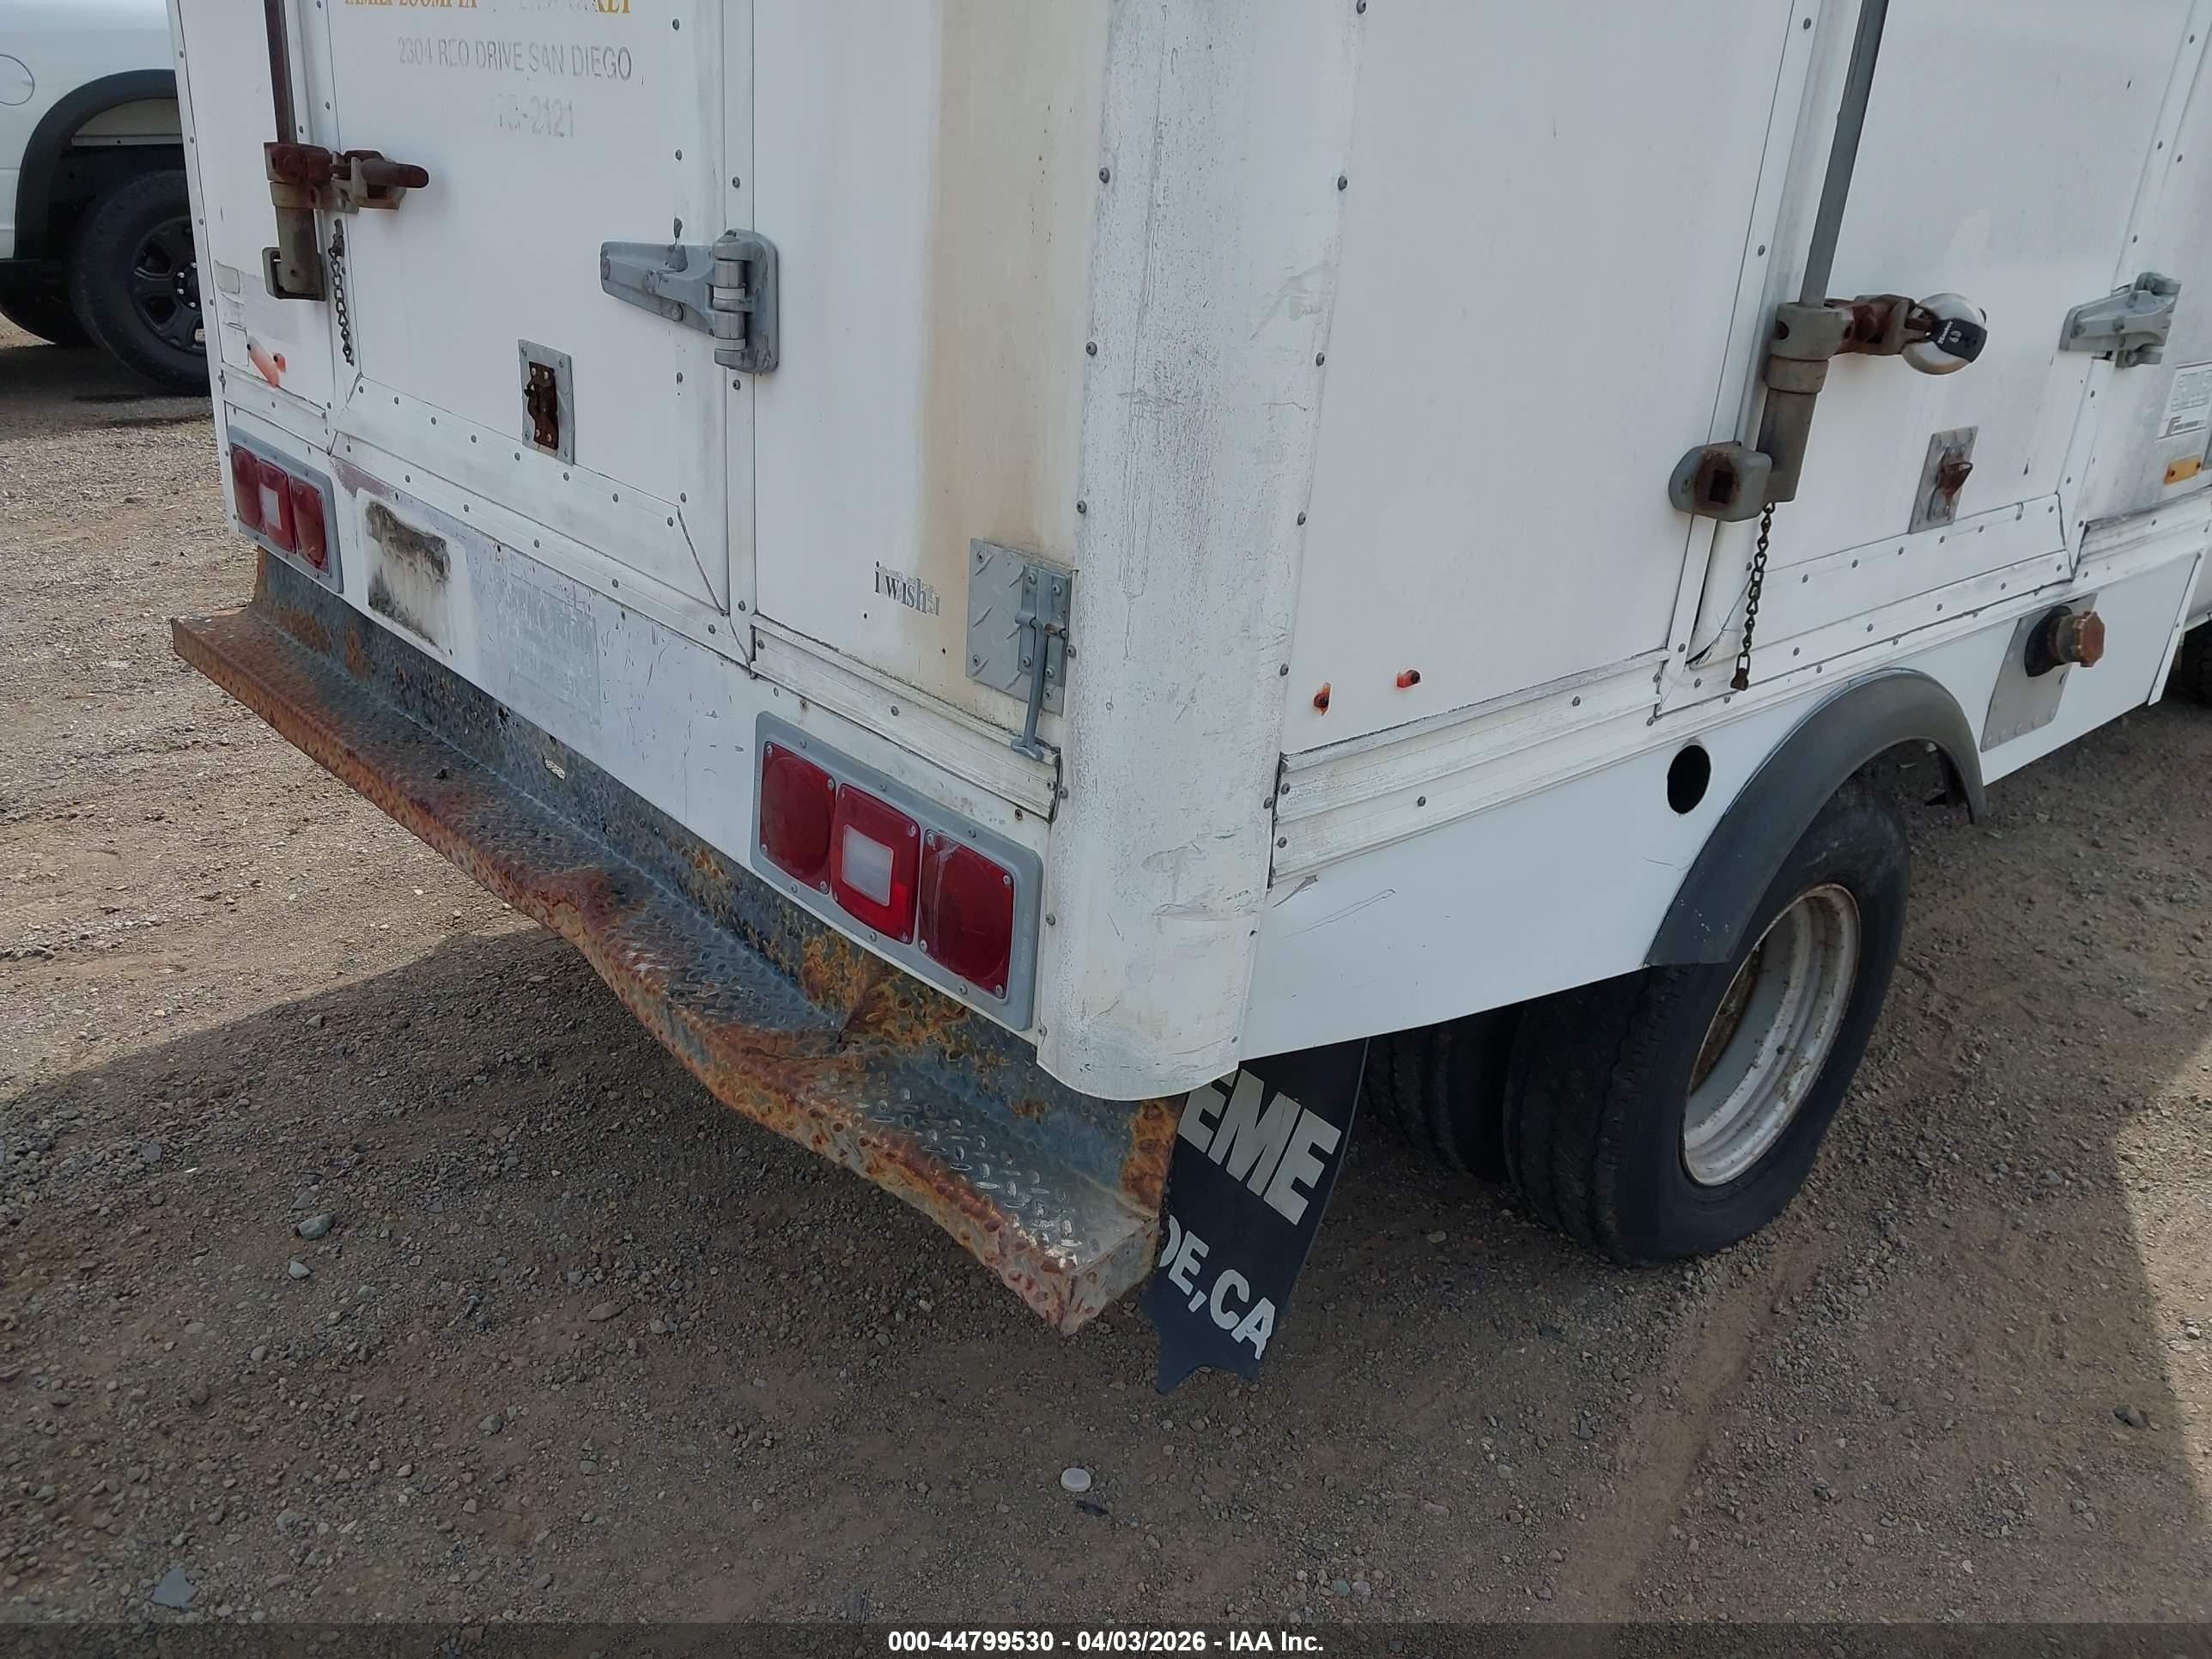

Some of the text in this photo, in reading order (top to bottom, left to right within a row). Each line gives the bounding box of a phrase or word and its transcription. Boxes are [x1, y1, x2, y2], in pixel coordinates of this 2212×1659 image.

[398, 38, 436, 68] 2304
[475, 42, 523, 75] DRIVE
[529, 42, 563, 76] SAN
[571, 45, 631, 80] DIEGO
